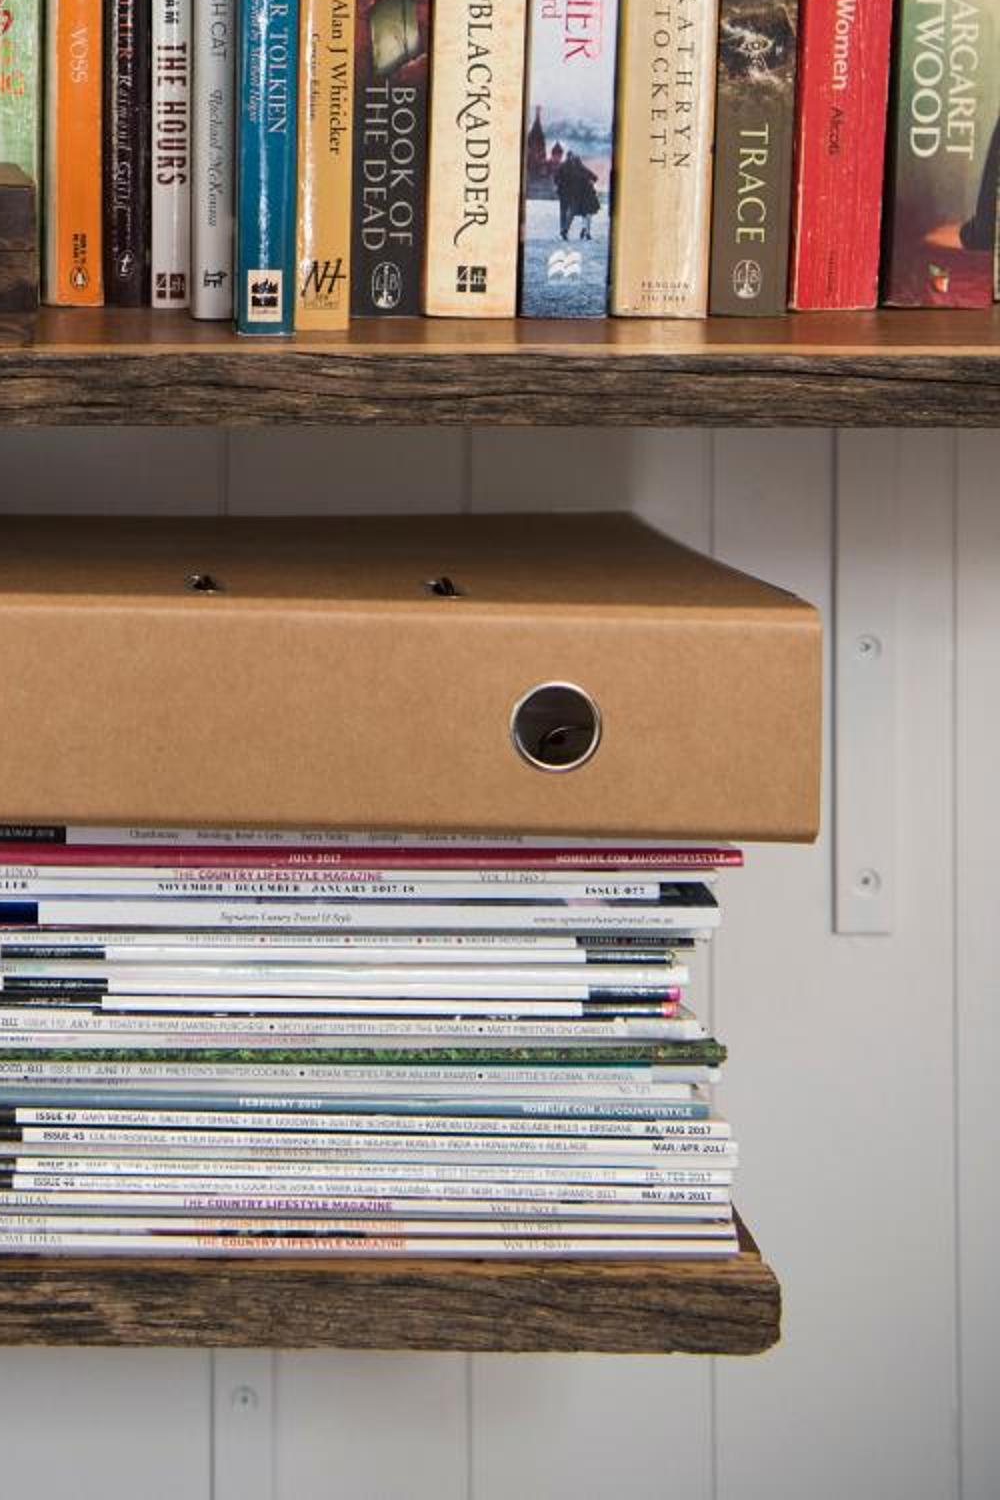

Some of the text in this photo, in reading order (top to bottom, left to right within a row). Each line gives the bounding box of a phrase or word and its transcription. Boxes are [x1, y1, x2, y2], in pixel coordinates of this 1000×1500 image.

[70, 25, 89, 83] VOSS
[210, 20, 227, 61] CAT
[328, 46, 348, 57] J
[267, 27, 288, 134] TOLKIEN
[156, 41, 187, 186] THE HOURS
[328, 62, 347, 155] Whiticker
[360, 77, 389, 252] THE DEAD
[388, 86, 418, 247] BOOK OF
[734, 122, 769, 245] TRACE
[287, 853, 342, 863] JULY 2017
[323, 872, 384, 882] MAGAZINE
[584, 885, 621, 895] ISSUE
[183, 1198, 393, 1213] THE COUNTRY LIFESTYLE MAGAZINE
[687, 1190, 712, 1201] 2017
[221, 1237, 278, 1248] COUNTRY
